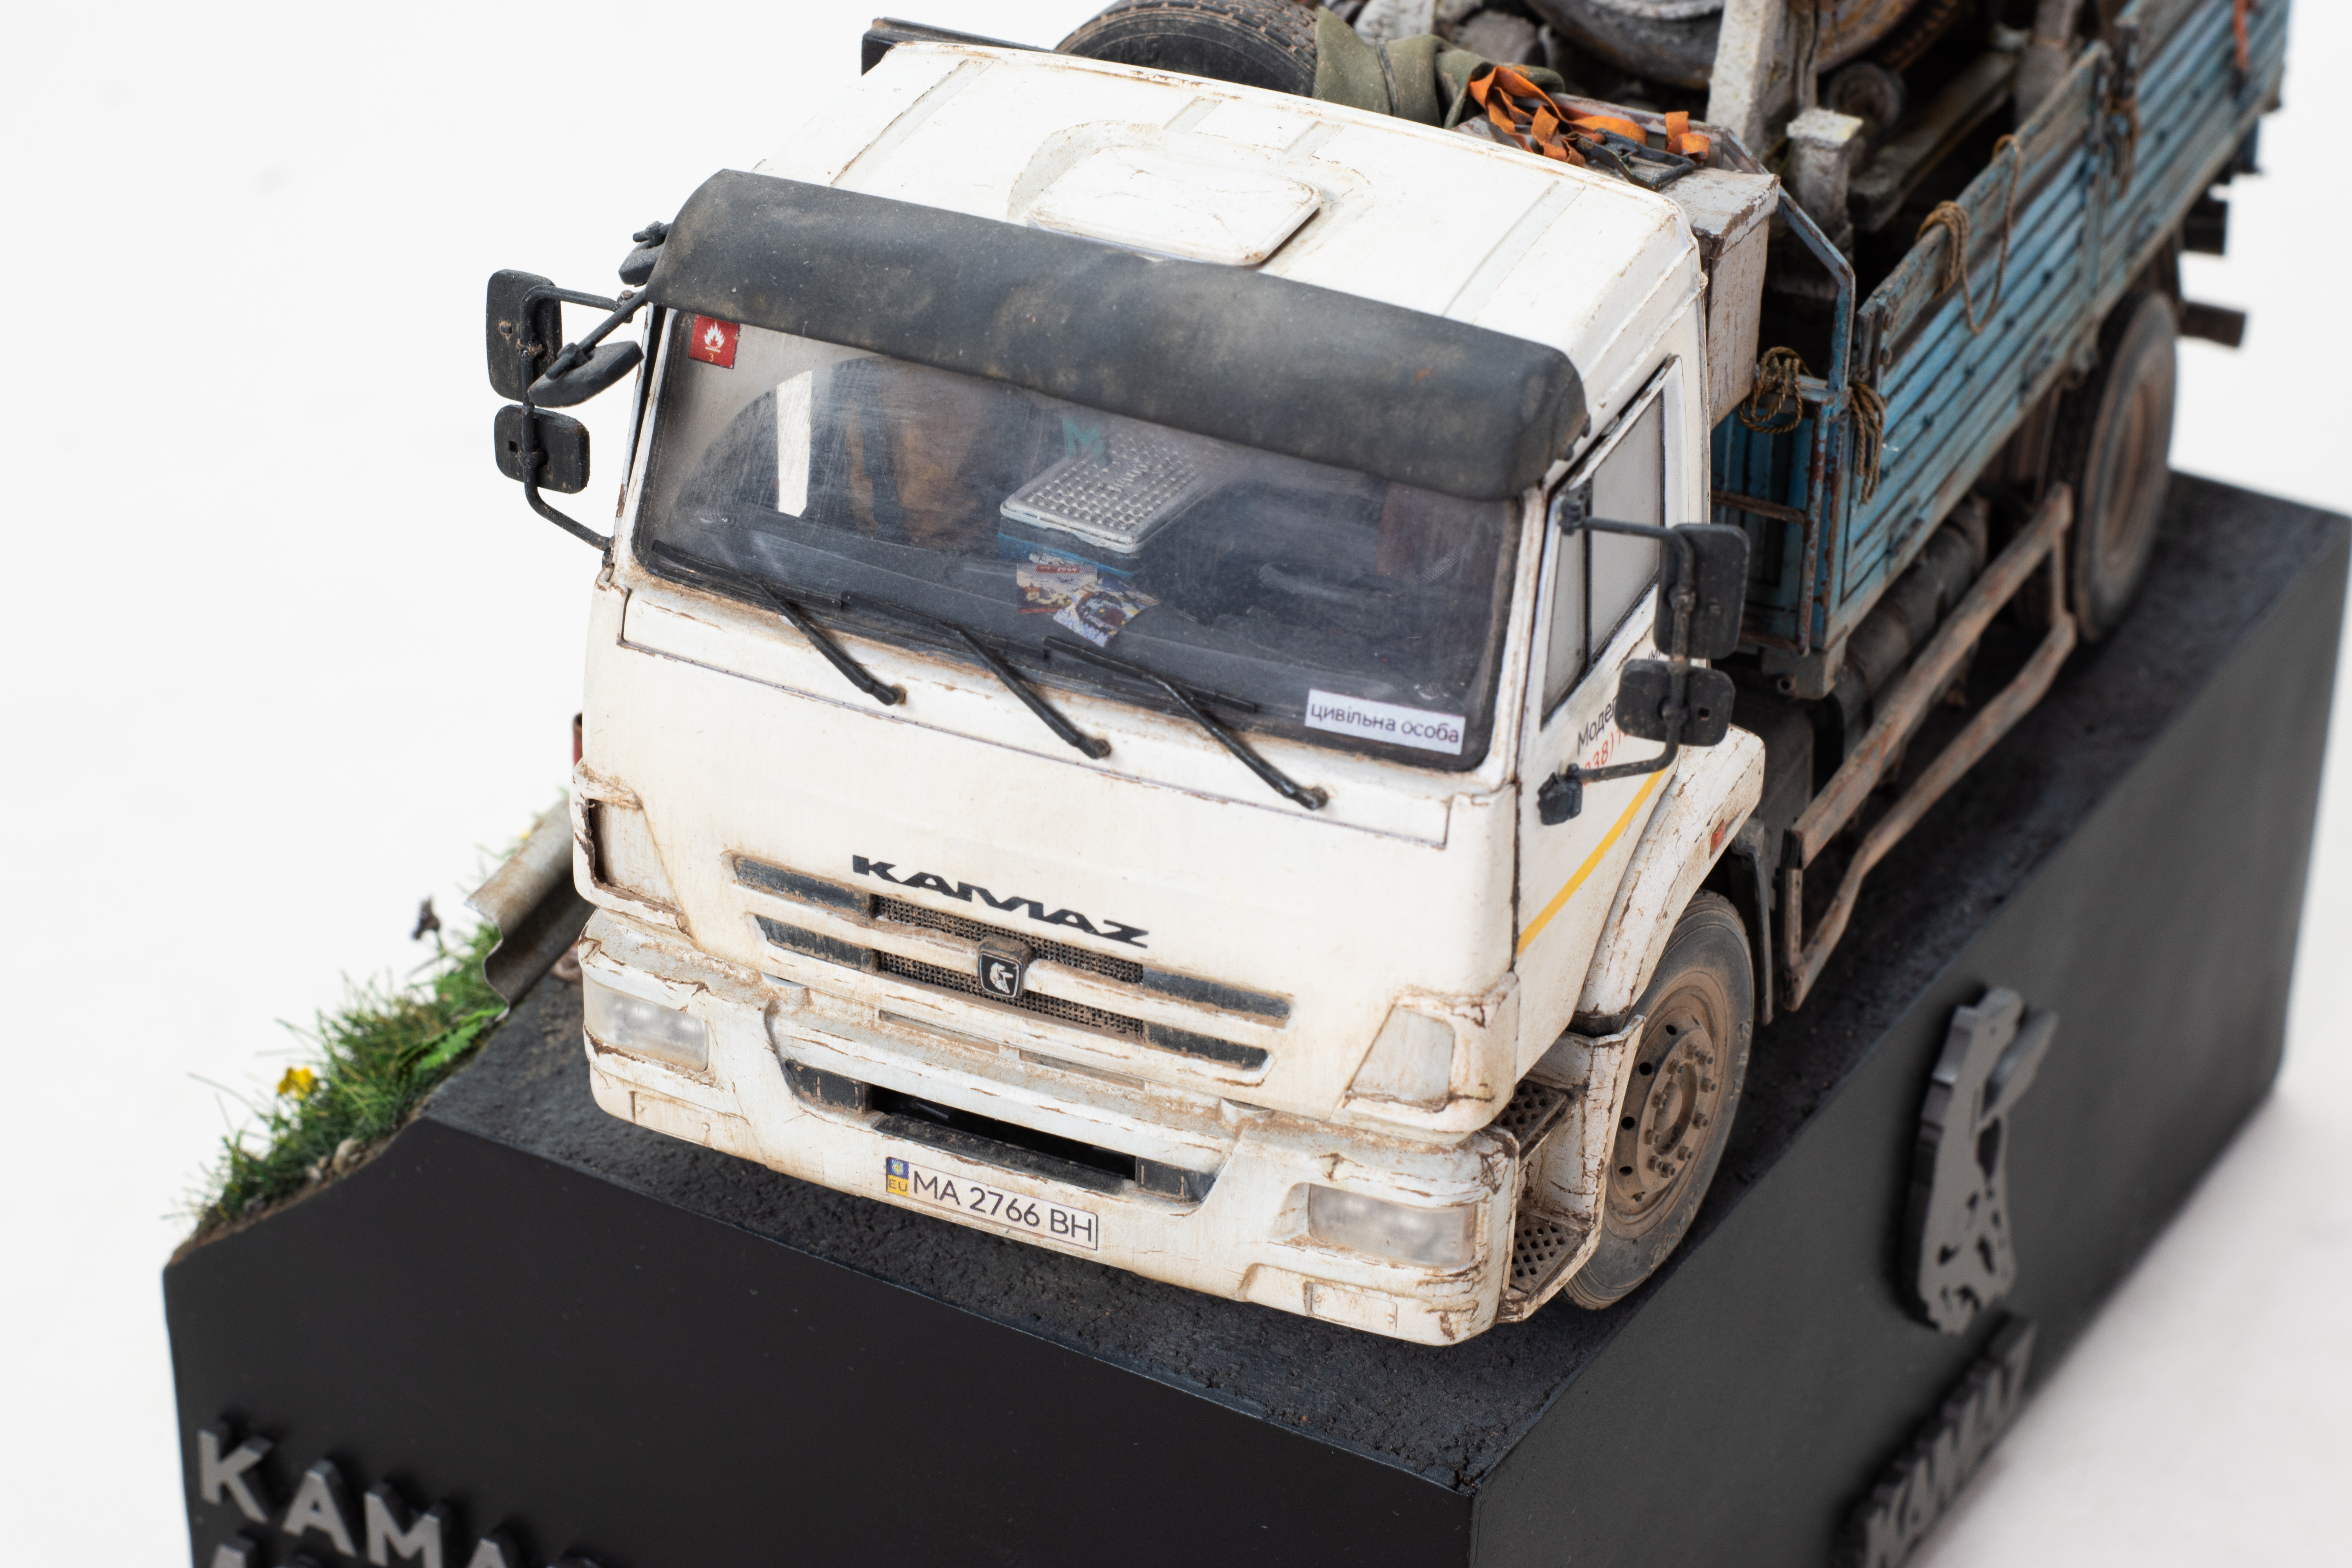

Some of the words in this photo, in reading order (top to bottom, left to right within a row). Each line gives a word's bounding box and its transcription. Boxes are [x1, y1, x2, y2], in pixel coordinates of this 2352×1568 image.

[1311, 704, 1396, 731] цивільна
[1401, 721, 1459, 743] особа
[1577, 697, 1617, 756] Модел
[852, 855, 1149, 949] KAMAZ
[888, 1179, 907, 1192] EU
[914, 1171, 961, 1206] MA
[969, 1187, 1040, 1227] 2766
[1050, 1208, 1092, 1242] BH
